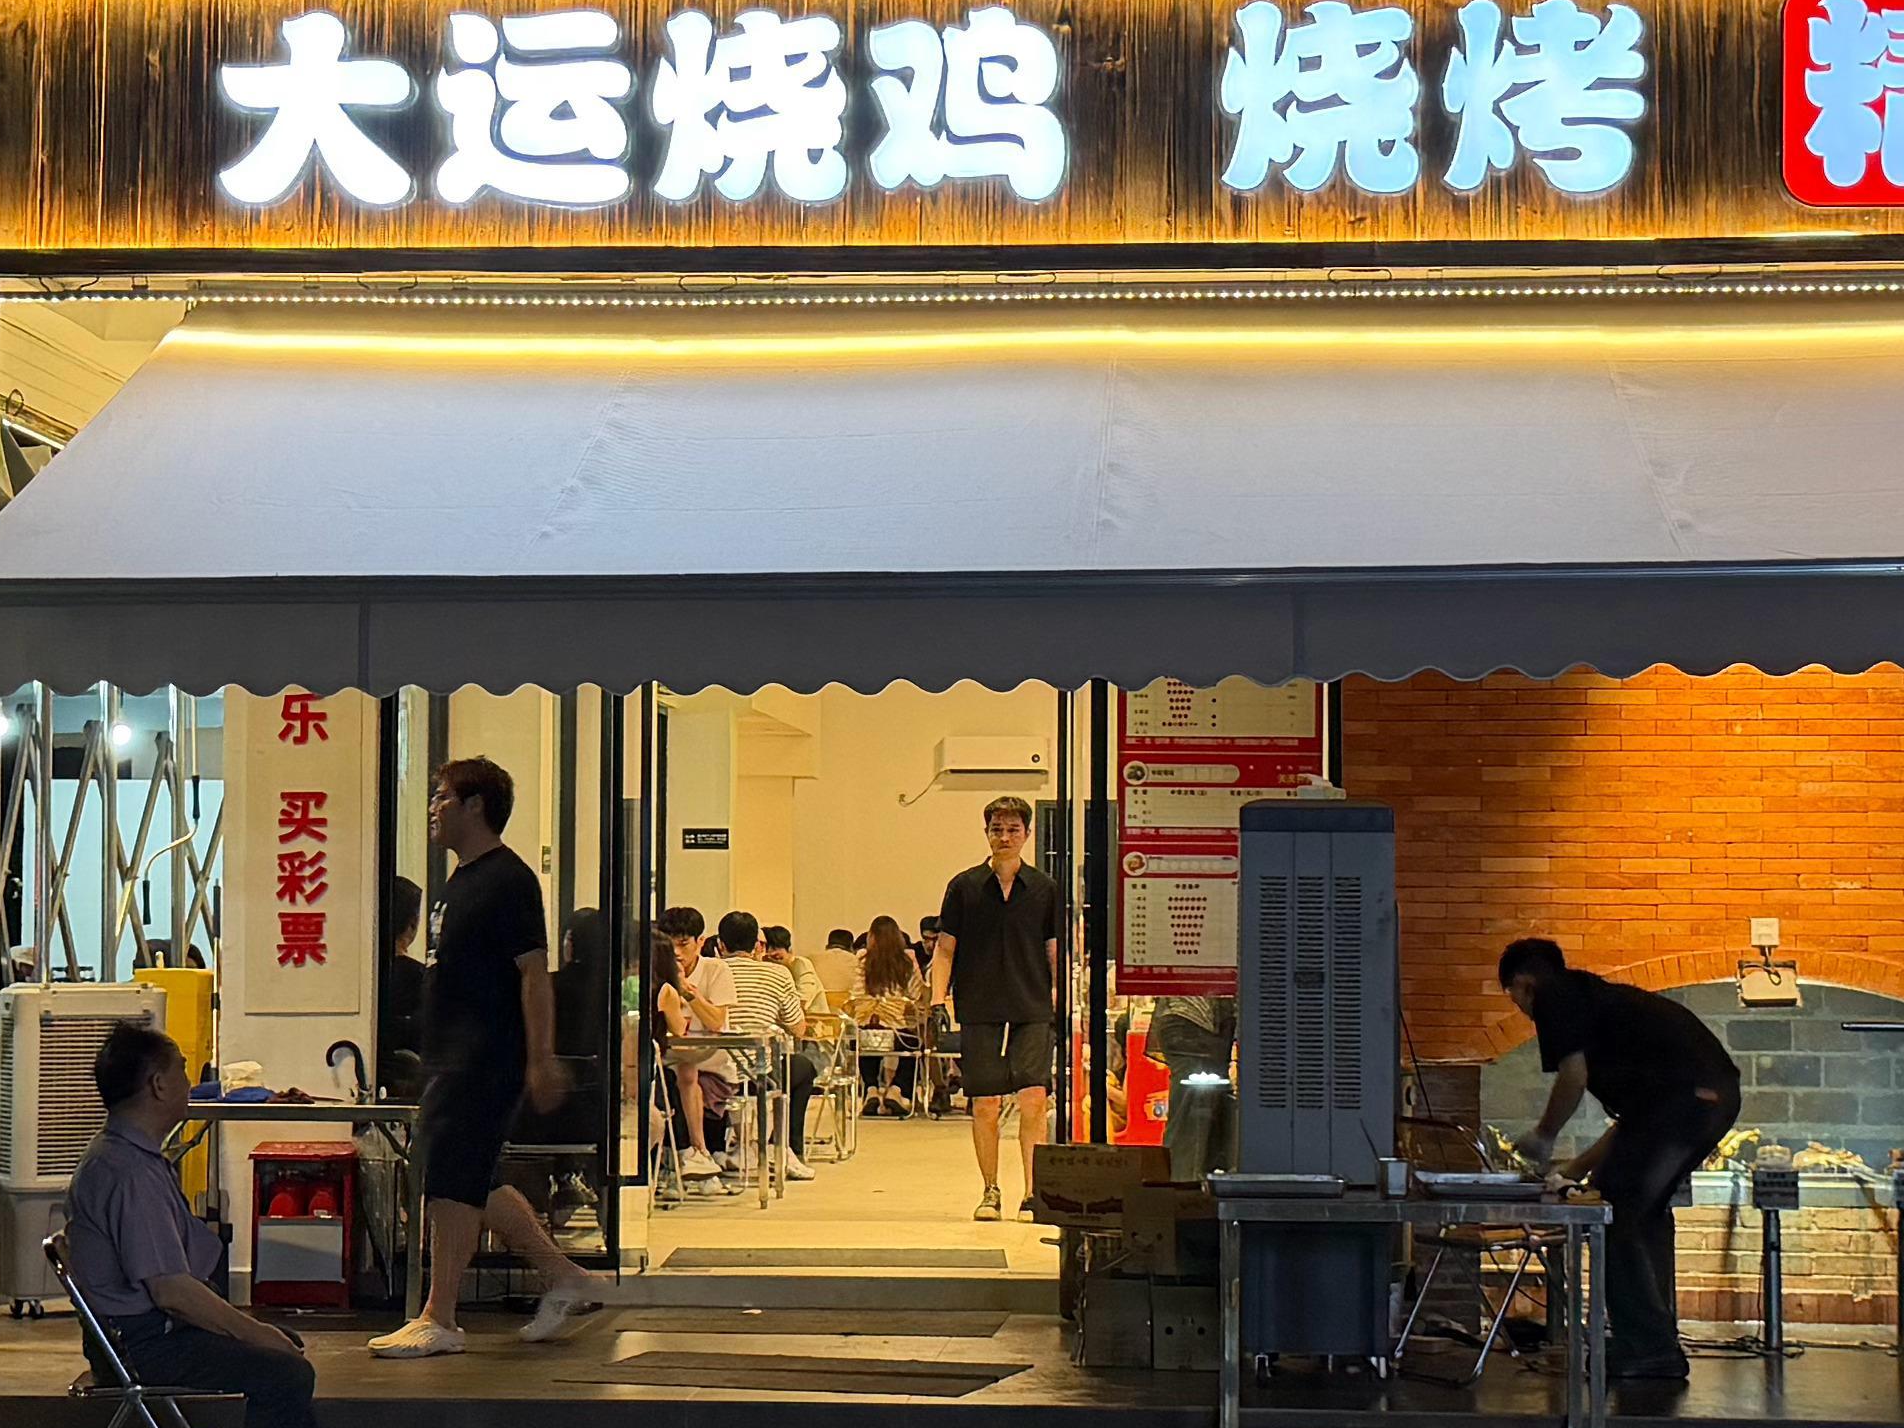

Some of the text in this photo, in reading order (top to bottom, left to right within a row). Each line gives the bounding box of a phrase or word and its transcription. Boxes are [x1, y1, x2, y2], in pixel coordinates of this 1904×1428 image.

[217, 4, 1067, 213] 大运烧鸡
[276, 790, 329, 967] 买彩票
